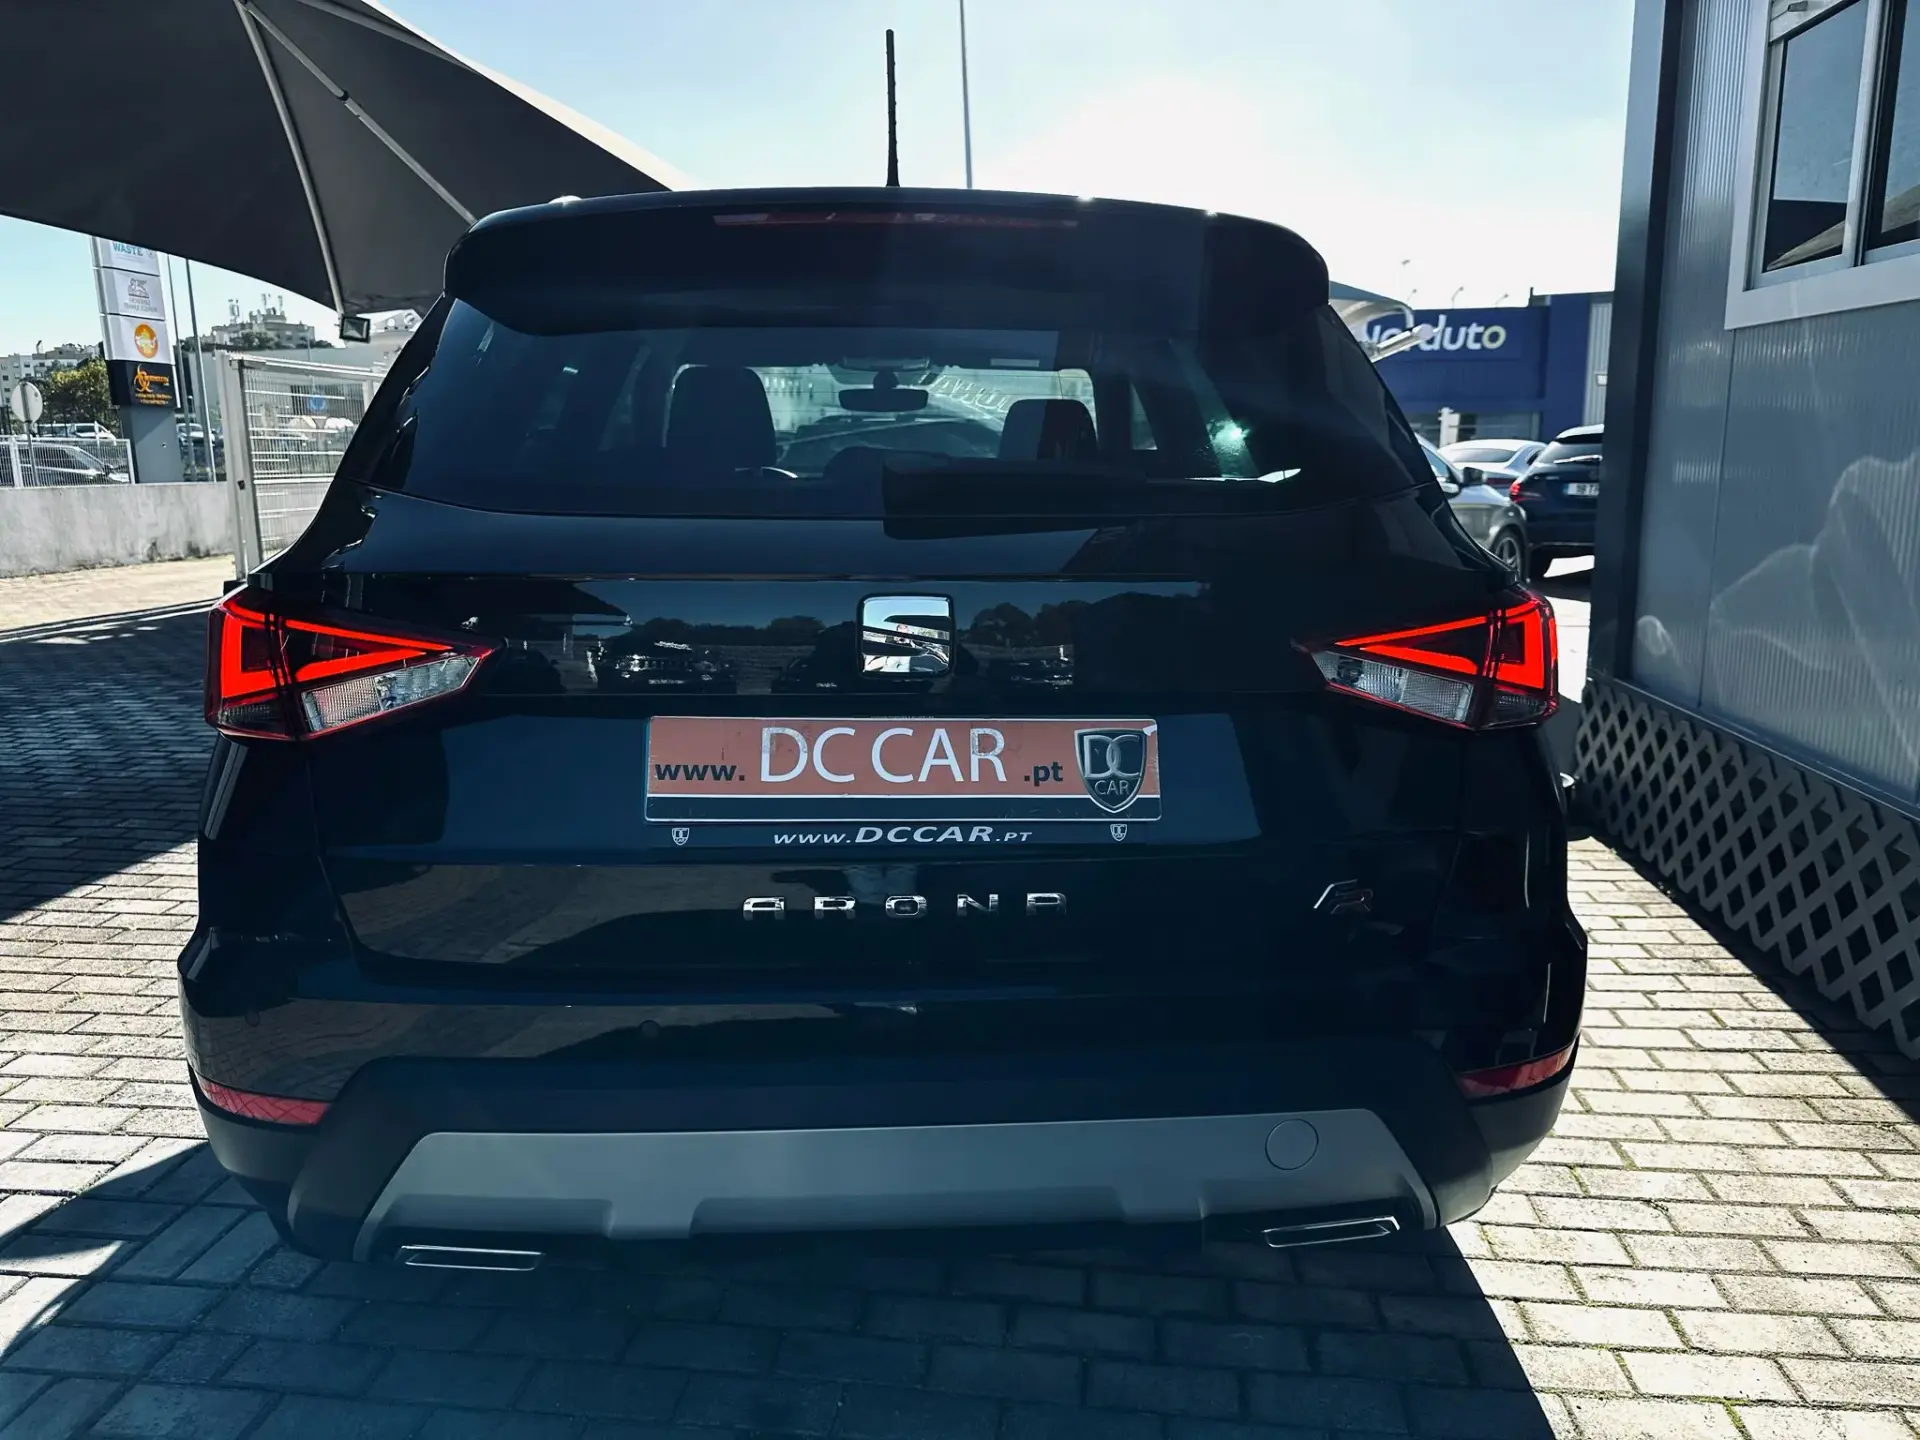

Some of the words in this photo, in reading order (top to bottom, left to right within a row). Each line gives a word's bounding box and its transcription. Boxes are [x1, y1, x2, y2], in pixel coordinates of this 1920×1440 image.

[112, 242, 144, 257] WASTE
[654, 763, 745, 781] www.
[760, 726, 856, 783] DC
[871, 727, 1007, 783] CAR
[1023, 761, 1063, 787] .pt
[1084, 734, 1141, 779] DC
[1094, 780, 1130, 796] CAR
[773, 826, 1033, 844] www.DCCAR.PT
[743, 892, 1067, 921] ARONA
